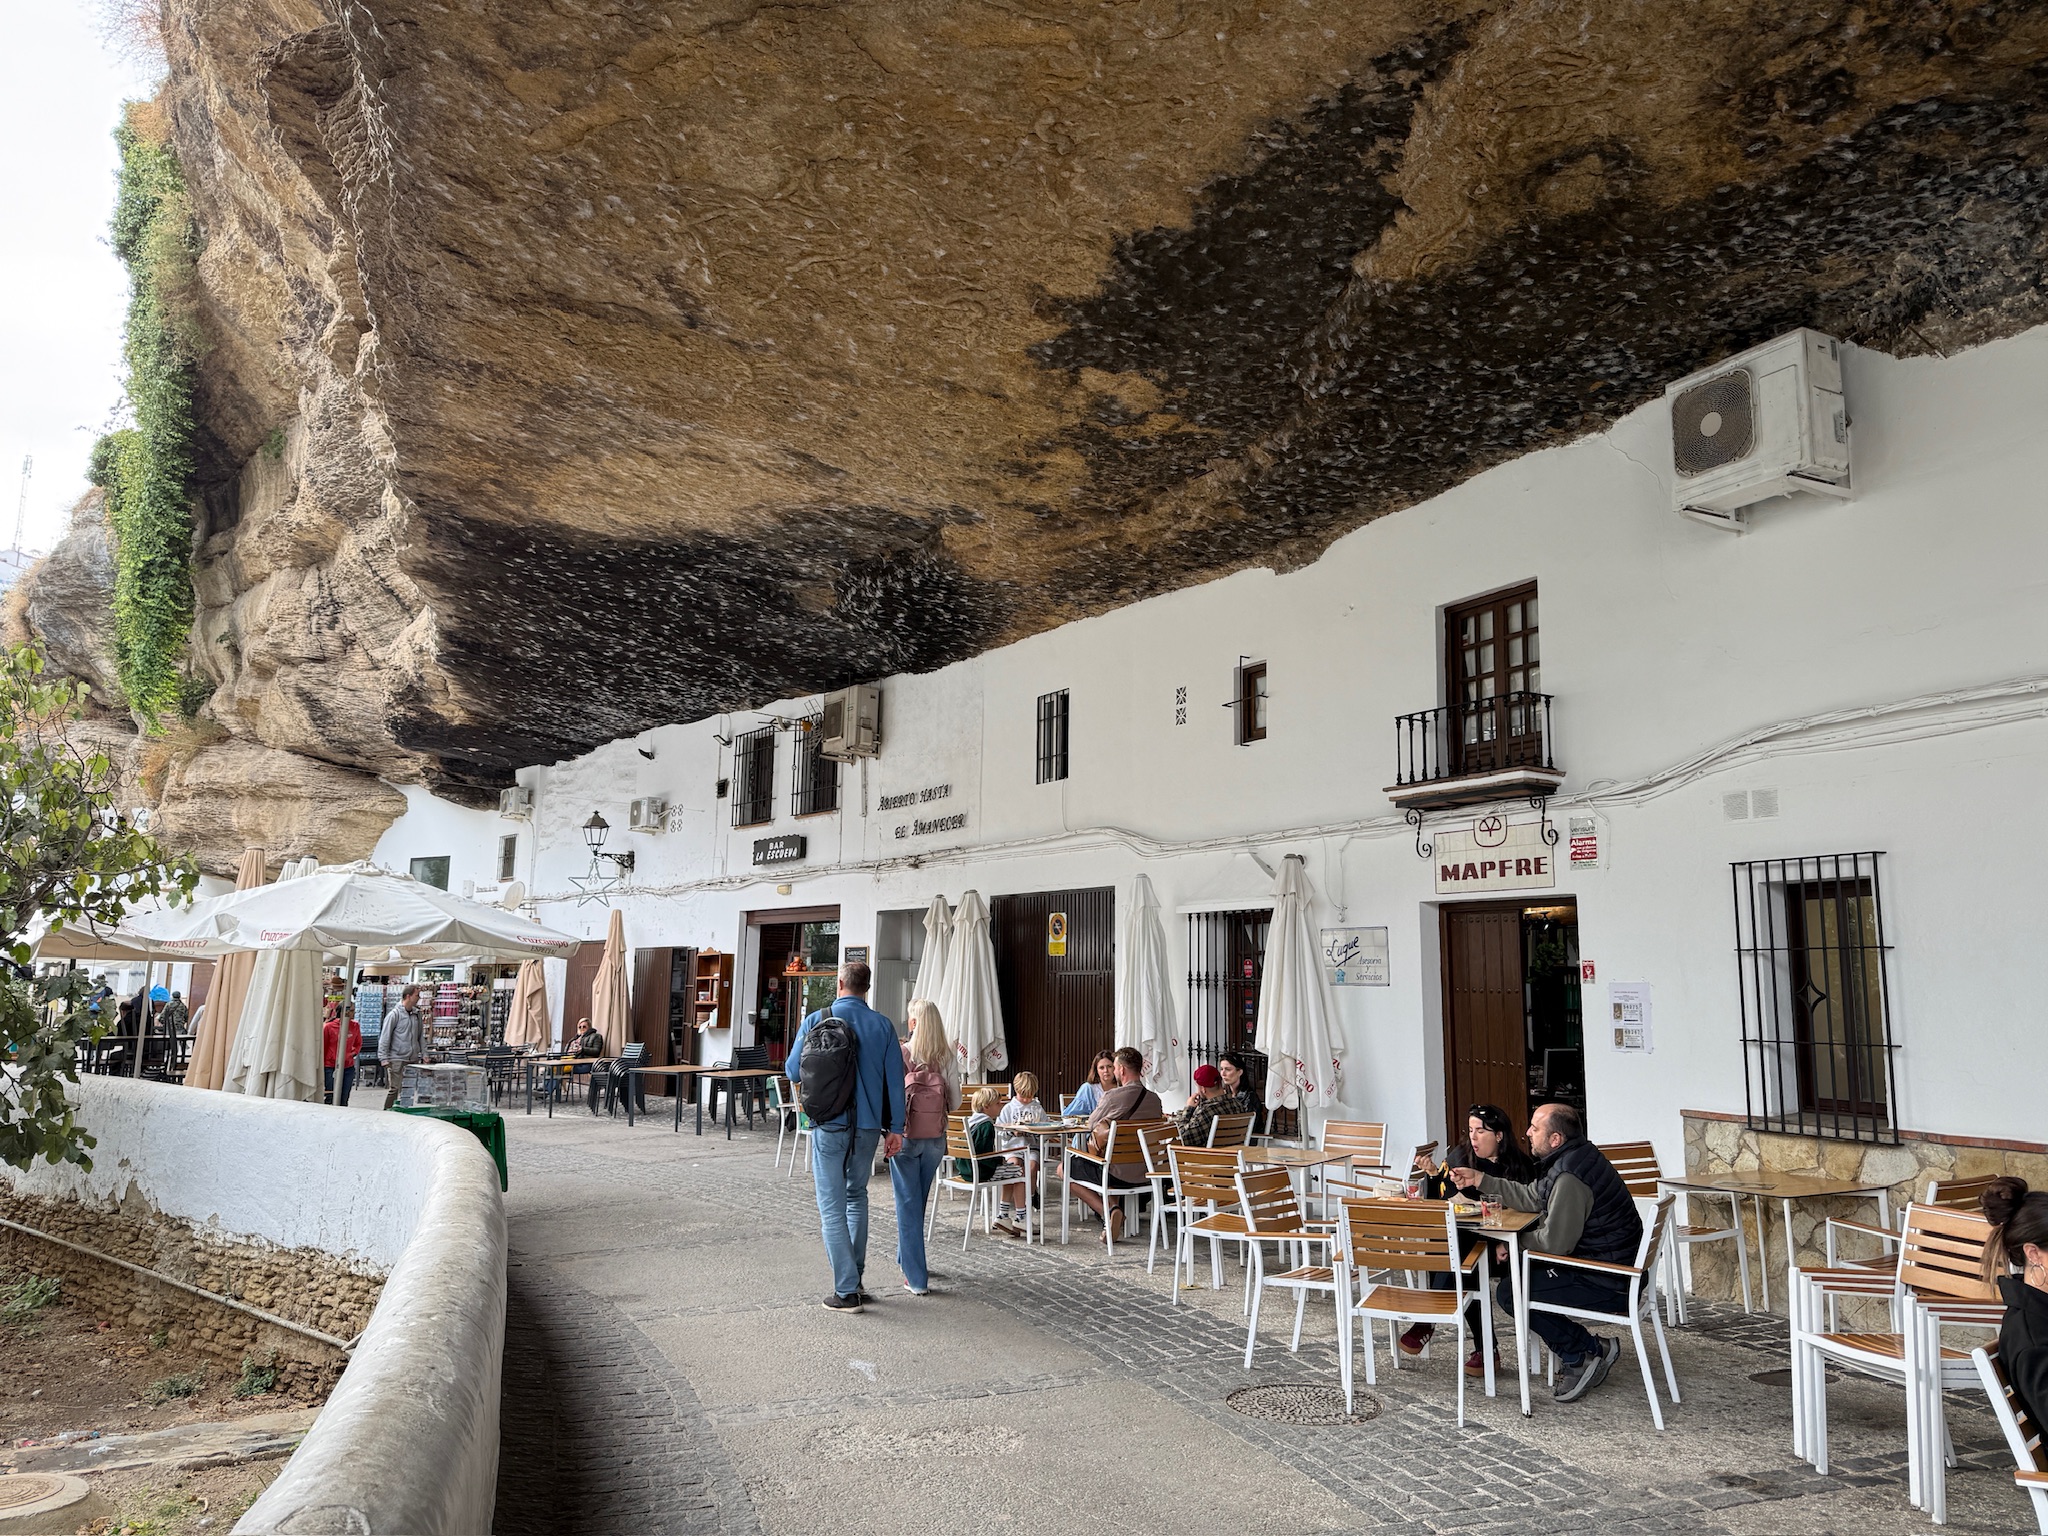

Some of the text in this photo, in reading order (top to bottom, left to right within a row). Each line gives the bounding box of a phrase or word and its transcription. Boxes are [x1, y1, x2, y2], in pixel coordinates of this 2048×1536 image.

[919, 784, 949, 803] HASTA
[911, 813, 966, 836] AMANECER
[769, 841, 784, 850] BAR
[1571, 838, 1597, 847] Alarma
[755, 847, 798, 861] LA ESCUEVA
[1441, 856, 1548, 881] MAPFRE
[516, 935, 569, 949] Cruzcampo
[1326, 936, 1360, 967] Luque
[1355, 971, 1383, 981] Servicios
